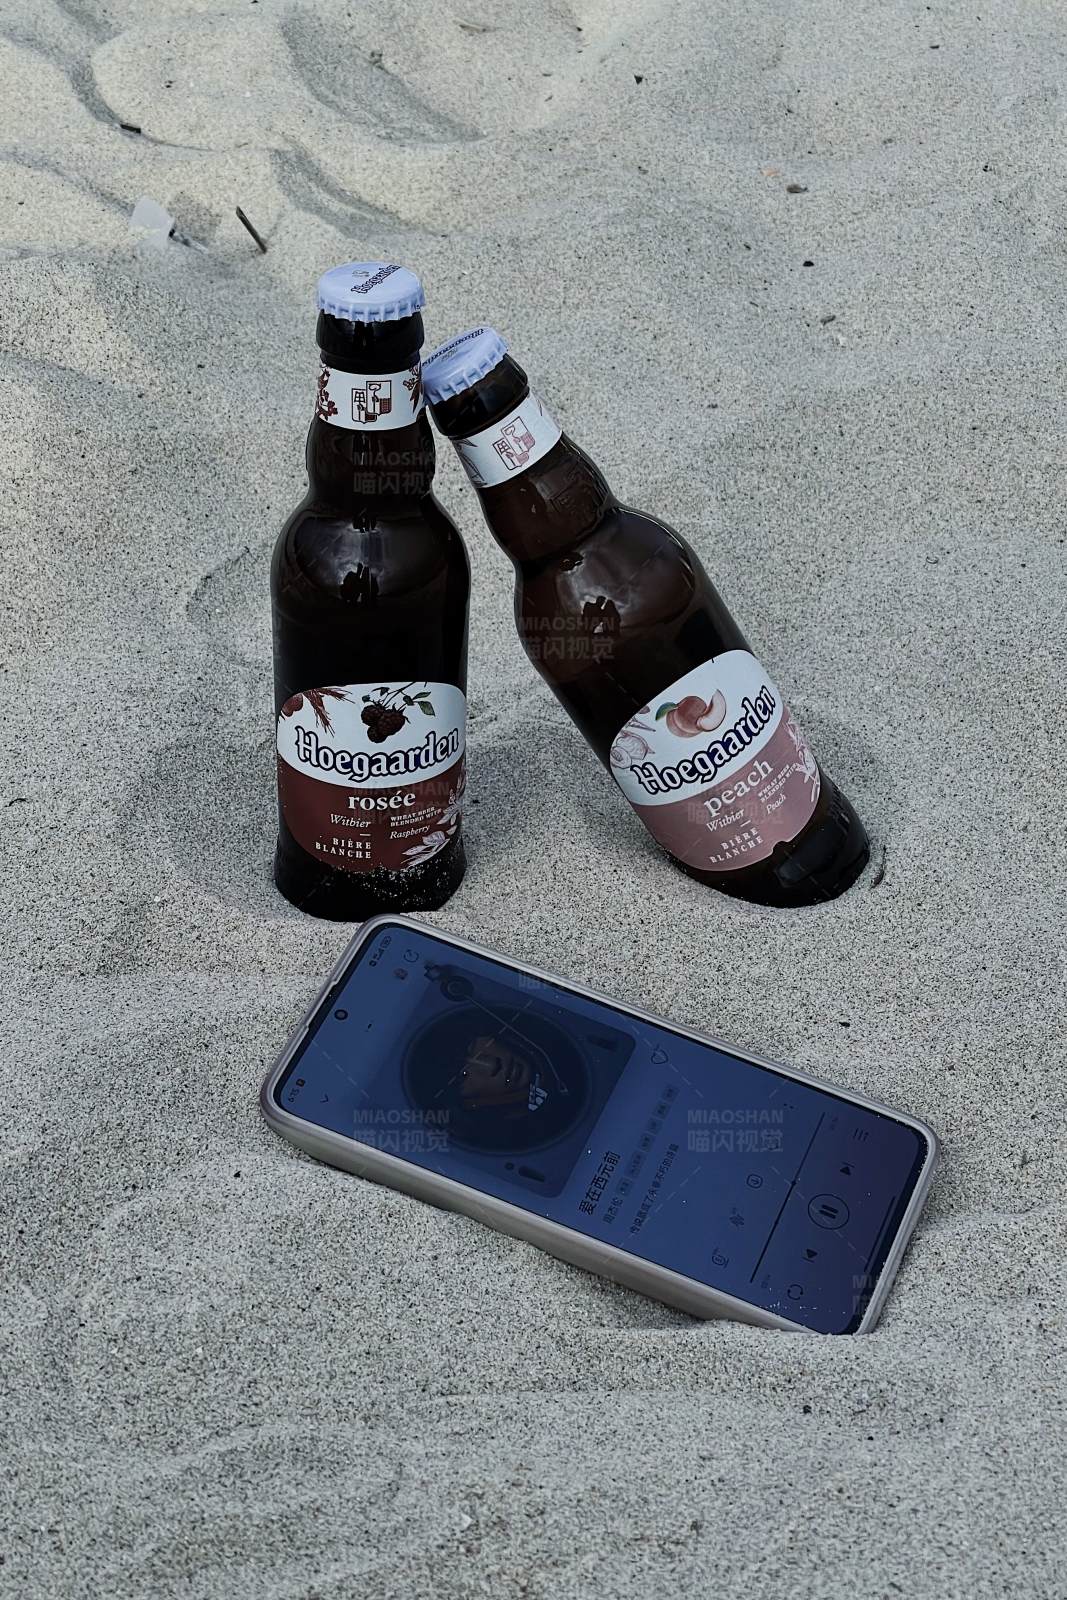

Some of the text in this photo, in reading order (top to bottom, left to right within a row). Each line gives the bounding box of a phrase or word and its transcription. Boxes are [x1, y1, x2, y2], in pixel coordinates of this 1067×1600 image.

[631, 685, 775, 795] Hoegaarden
[295, 726, 459, 783] Hoegaarden
[703, 758, 773, 818] peach
[348, 790, 416, 811] rosée
[767, 793, 787, 814] Peach
[330, 813, 372, 829] Witbier
[389, 824, 430, 839] Raspberry
[706, 809, 745, 833] Witbier
[315, 841, 372, 859] BLANCHE
[332, 837, 372, 850] BIÈRE
[709, 837, 764, 863] BLANCHE
[721, 826, 760, 850] BIÈRE
[579, 1150, 621, 1215] 爱在西元前
